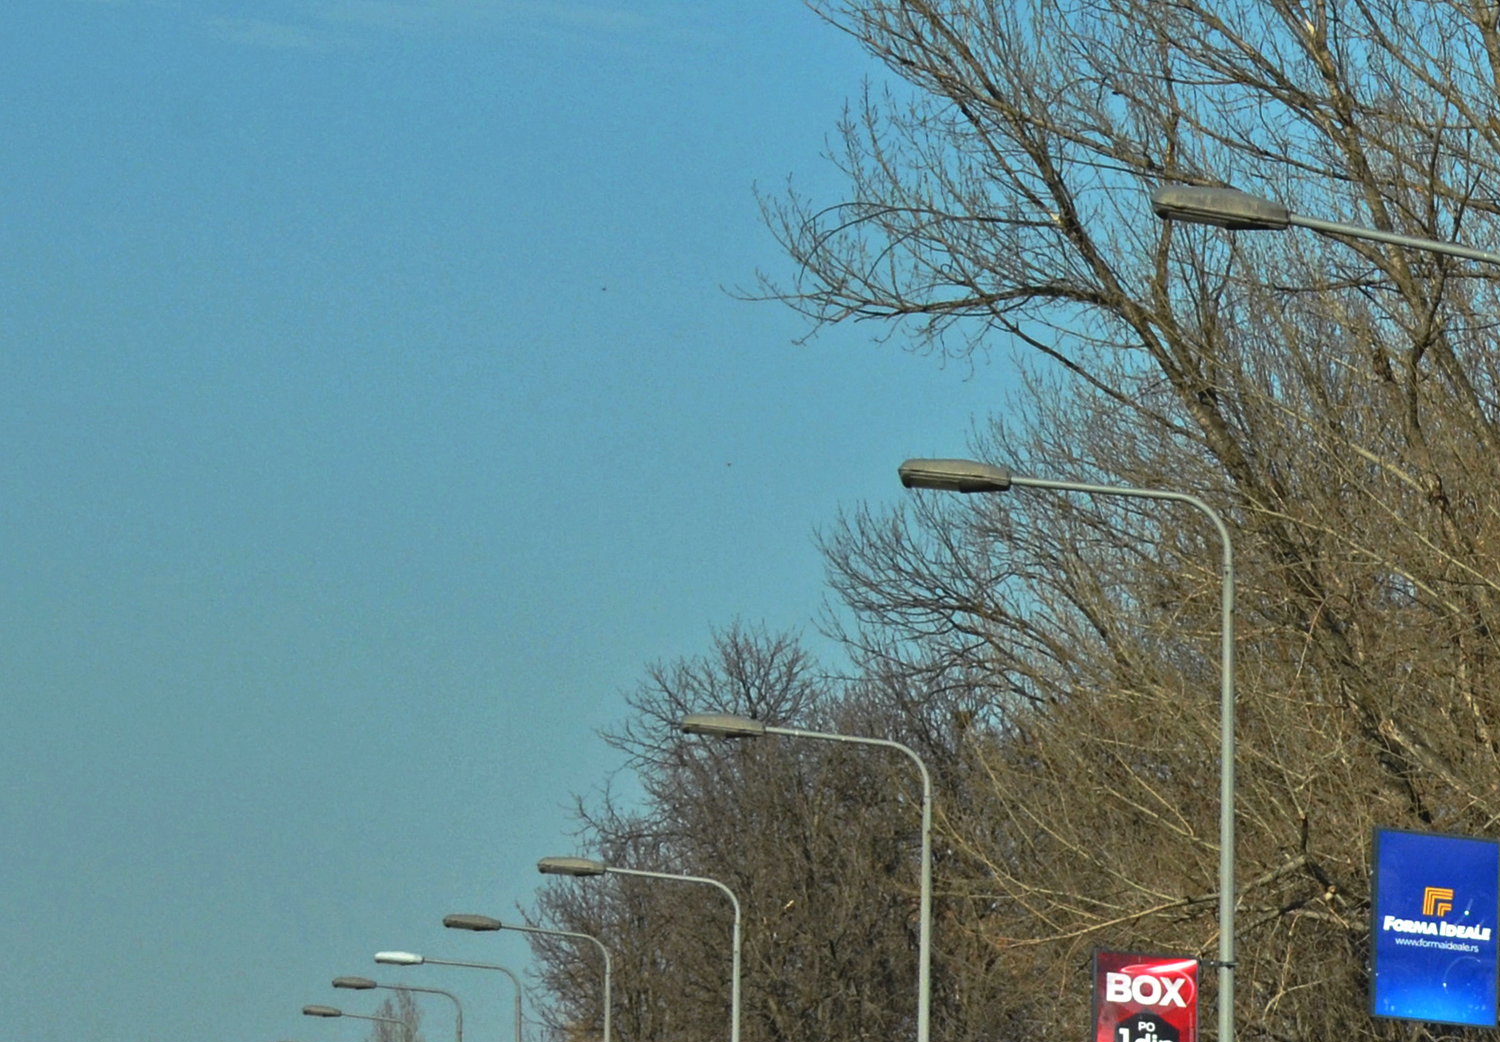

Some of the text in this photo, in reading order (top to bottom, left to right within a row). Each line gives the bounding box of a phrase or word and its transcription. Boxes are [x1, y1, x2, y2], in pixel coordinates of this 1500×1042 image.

[1383, 915, 1491, 941] FORMA IDEALE
[1395, 938, 1479, 953] www.formaideale.rs
[1106, 972, 1187, 1008] BOX
[1138, 1021, 1156, 1032] PO
